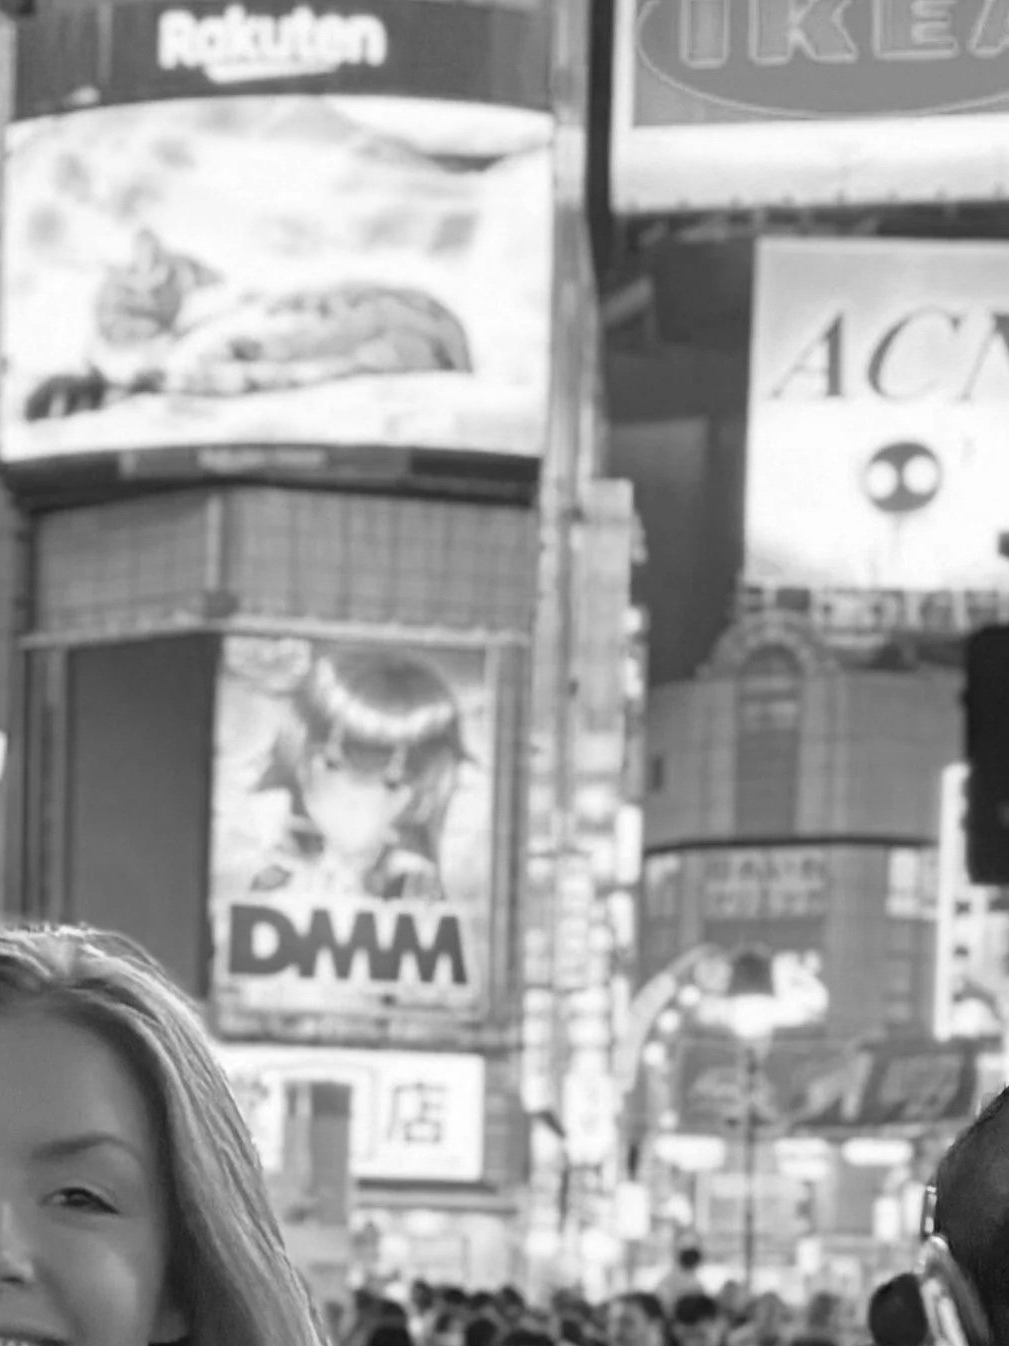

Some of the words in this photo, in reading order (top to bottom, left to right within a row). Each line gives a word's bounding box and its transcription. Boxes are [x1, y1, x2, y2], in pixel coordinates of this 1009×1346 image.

[156, 4, 388, 78] Rakuten
[229, 904, 468, 985] DMM
[388, 1081, 446, 1142] 店
